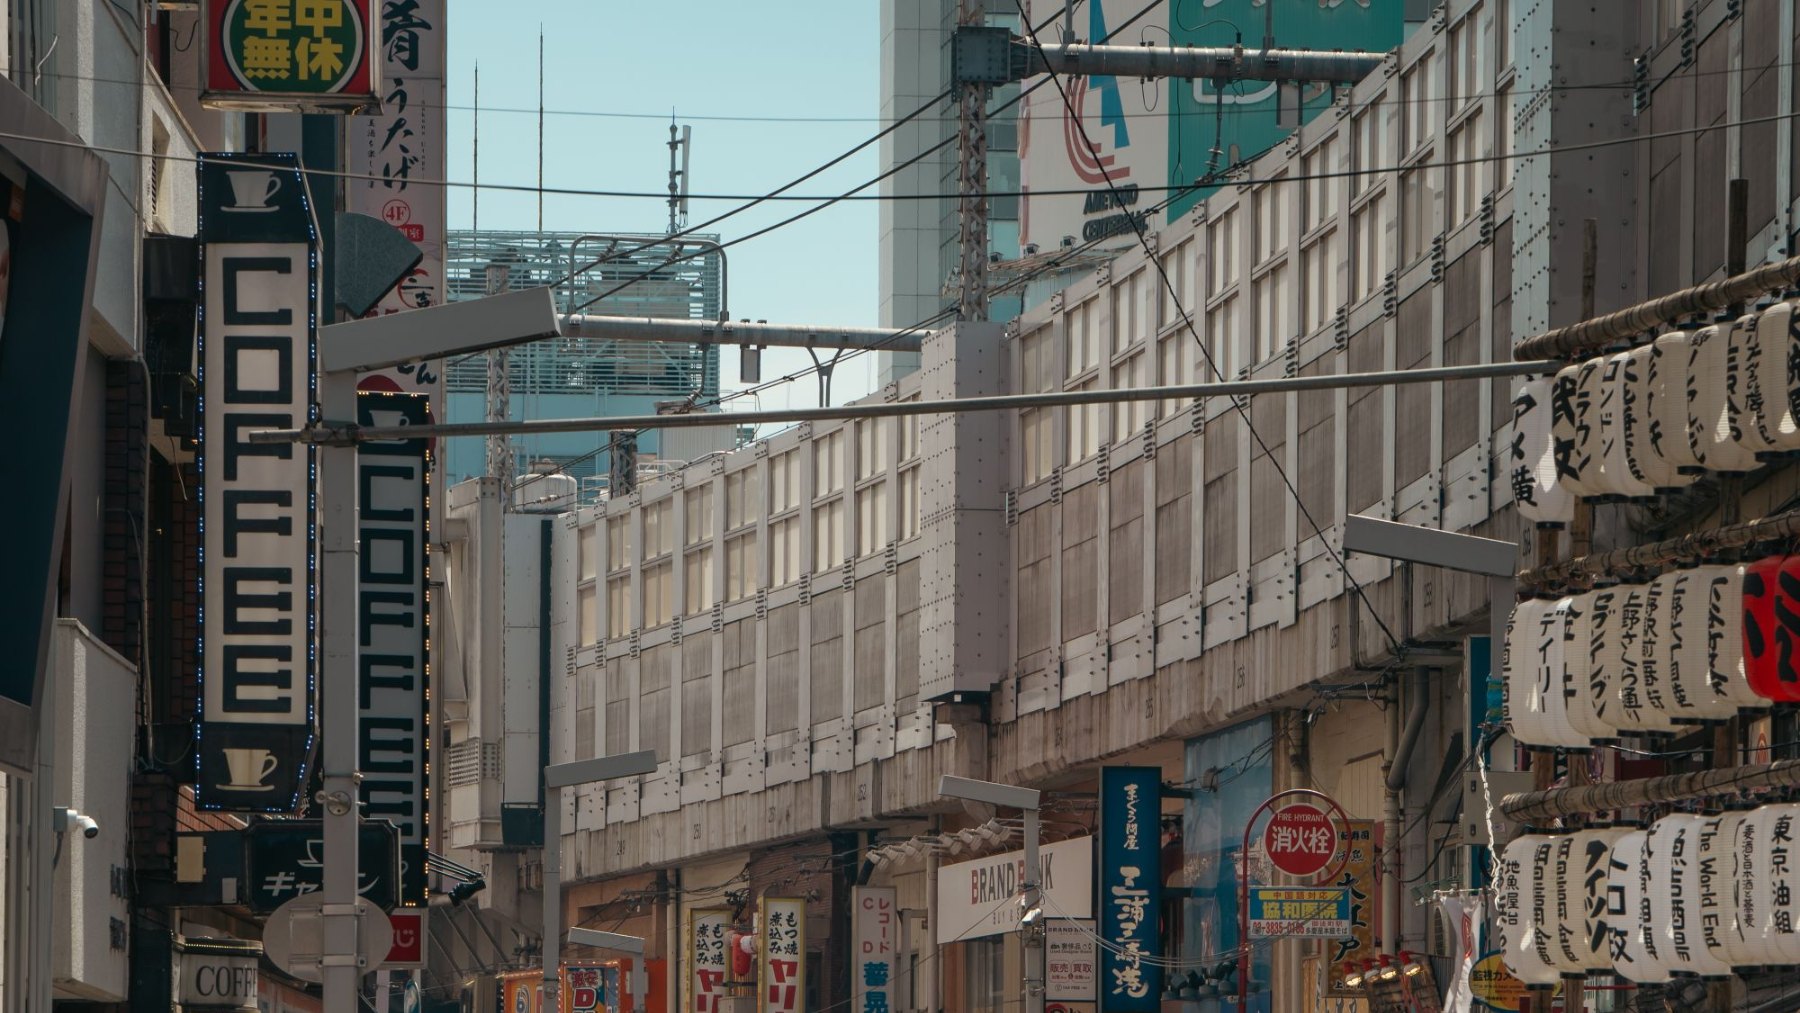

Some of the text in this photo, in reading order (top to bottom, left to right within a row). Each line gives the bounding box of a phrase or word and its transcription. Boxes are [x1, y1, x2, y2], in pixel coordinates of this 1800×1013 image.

[243, 0, 343, 37] 年中
[243, 37, 343, 81] 無休
[386, 206, 407, 221] 4F
[1600, 359, 1622, 459] ロンドン
[1511, 394, 1538, 508] アメ横
[222, 256, 293, 714] COFFEE
[1621, 591, 1644, 723] 上野さくら通り
[1271, 826, 1330, 854] 消火栓
[1277, 813, 1324, 823] FIRE HYDRANT
[971, 862, 1015, 905] BRAND
[1700, 818, 1722, 948] The World End
[1771, 814, 1794, 934] 東京油組
[696, 923, 710, 966] 煮込み
[711, 923, 725, 966] もつ焼
[769, 911, 783, 955] 煮込み
[783, 911, 799, 956] もつ焼
[878, 897, 890, 954] レコード
[1049, 963, 1069, 973] 販売
[1073, 963, 1092, 973] 買取
